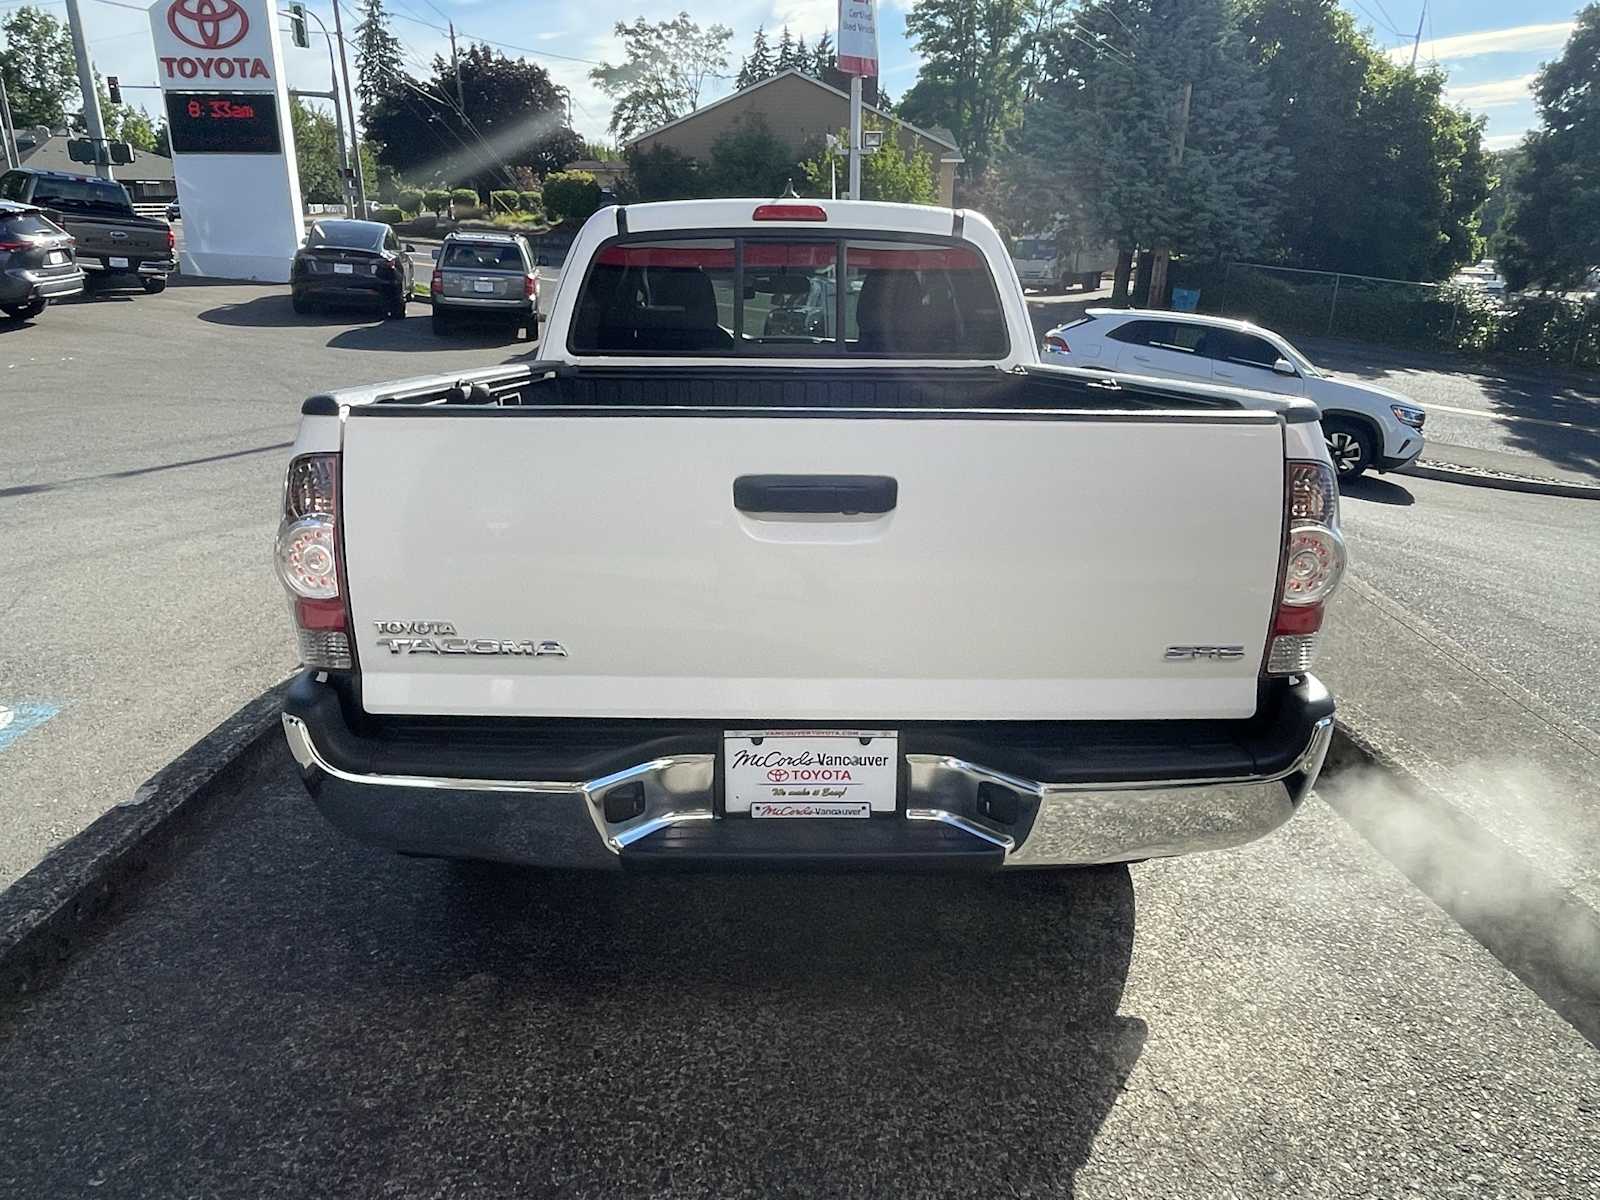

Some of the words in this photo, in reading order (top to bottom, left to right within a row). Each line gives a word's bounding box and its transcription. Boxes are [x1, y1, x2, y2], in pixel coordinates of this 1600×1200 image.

[160, 57, 270, 79] TOYOTA
[374, 620, 456, 636] TOYOTA
[377, 637, 568, 657] TACOMA
[732, 750, 818, 769] McCords
[817, 752, 889, 767] Vancouver
[792, 769, 852, 781] TOYOTA
[760, 805, 815, 816] McCords
[814, 807, 862, 816] Vancouver
